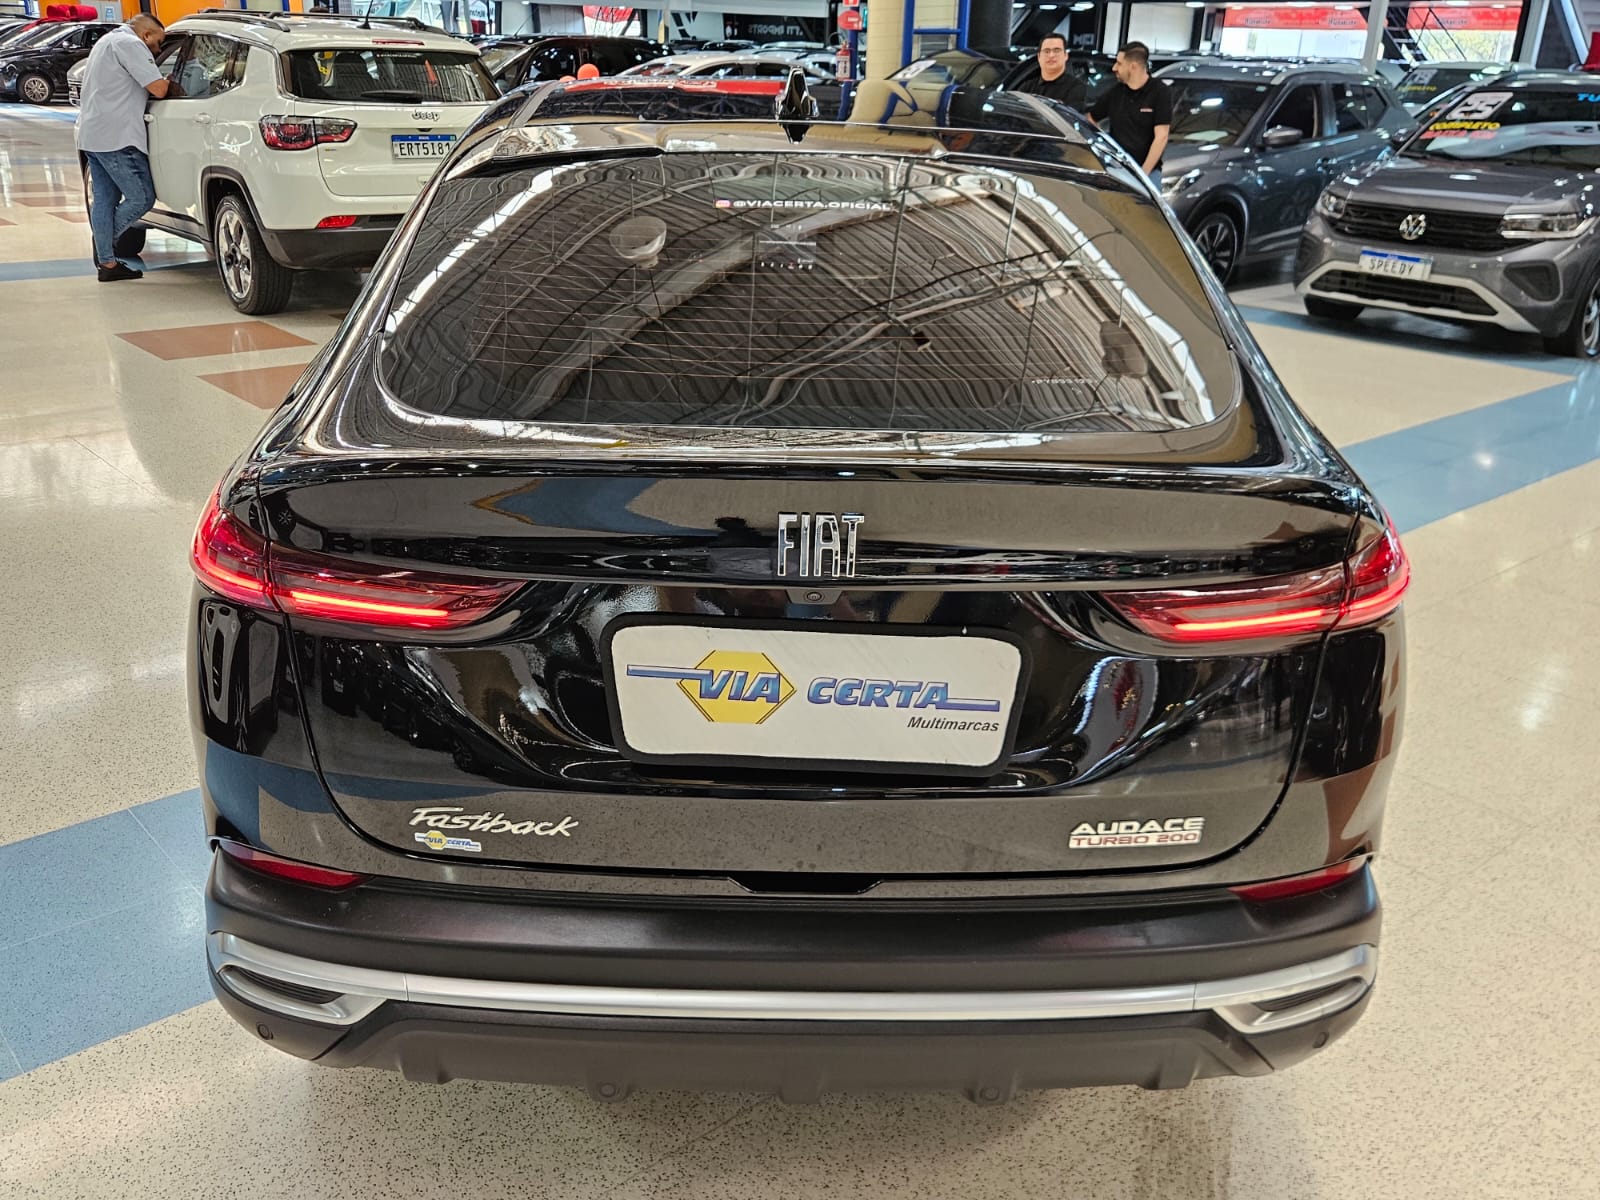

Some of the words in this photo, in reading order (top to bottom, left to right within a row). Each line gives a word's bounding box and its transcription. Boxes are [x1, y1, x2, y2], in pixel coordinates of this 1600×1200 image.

[411, 110, 440, 121] Jeep
[1429, 121, 1500, 131] COMPLETO
[733, 199, 892, 212] @VIACERTA.OFICIAL
[1368, 257, 1415, 275] SPEEDY
[777, 512, 865, 577] FIAT
[699, 669, 781, 703] VIA
[807, 676, 949, 710] CERTA
[906, 715, 1000, 732] Multimarcas
[409, 806, 579, 837] Fastback
[1070, 816, 1205, 835] AUDACE
[428, 837, 443, 845] VIA
[447, 839, 473, 847] CERTA
[1072, 834, 1150, 847] TURBO
[1156, 832, 1198, 843] 200
